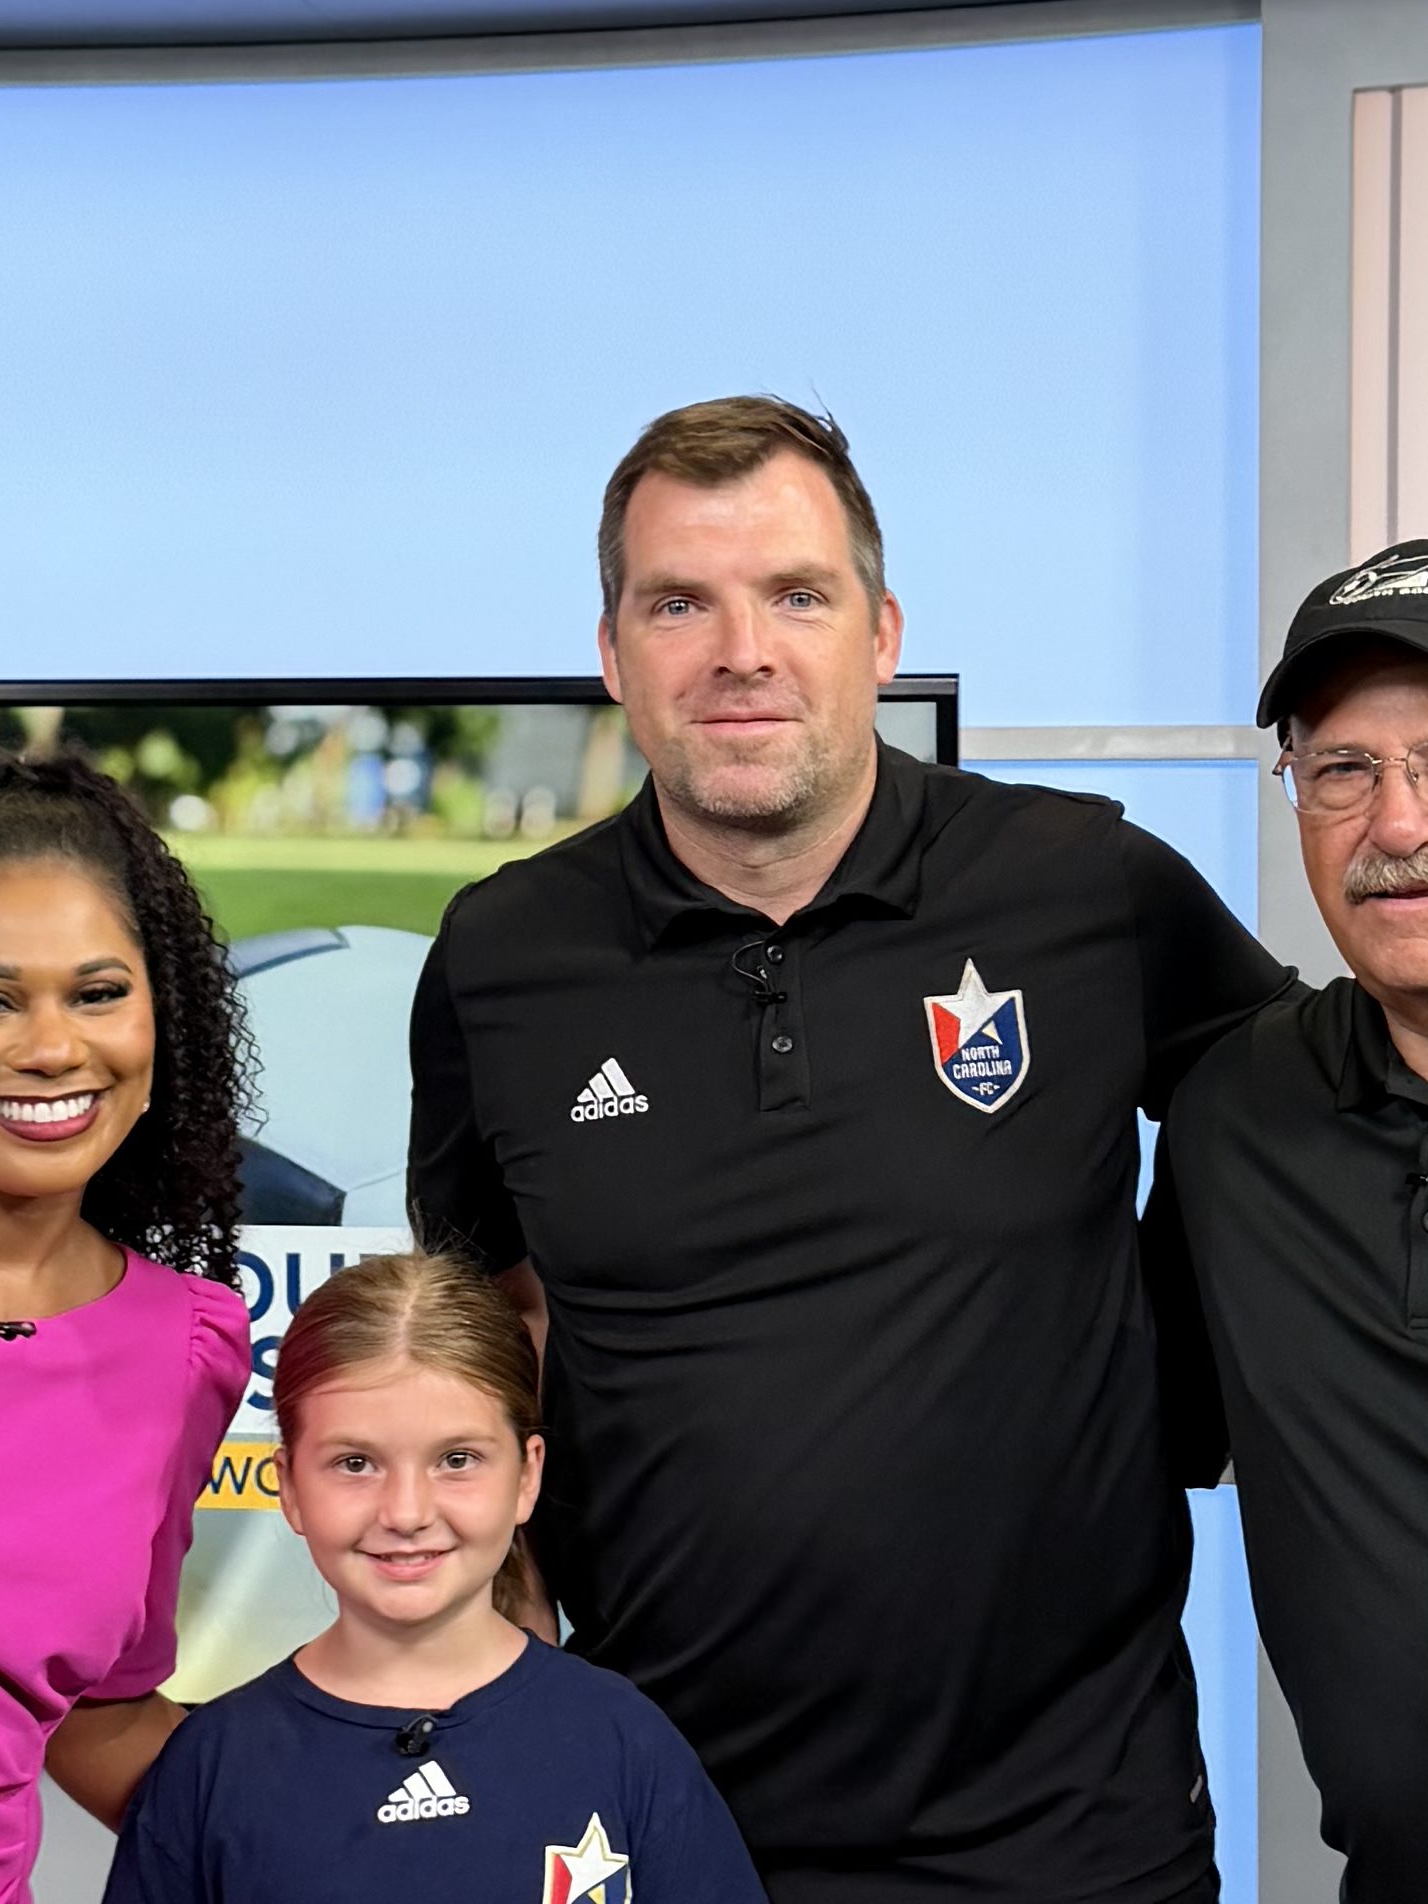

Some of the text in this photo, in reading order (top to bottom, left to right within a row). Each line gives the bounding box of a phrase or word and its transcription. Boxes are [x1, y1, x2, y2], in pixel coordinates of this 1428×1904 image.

[961, 1045, 1000, 1061] NORTH
[953, 1059, 1012, 1080] CAROLINA
[979, 1081, 994, 1095] FC
[570, 1094, 649, 1122] adidas
[377, 1795, 470, 1823] adidas
